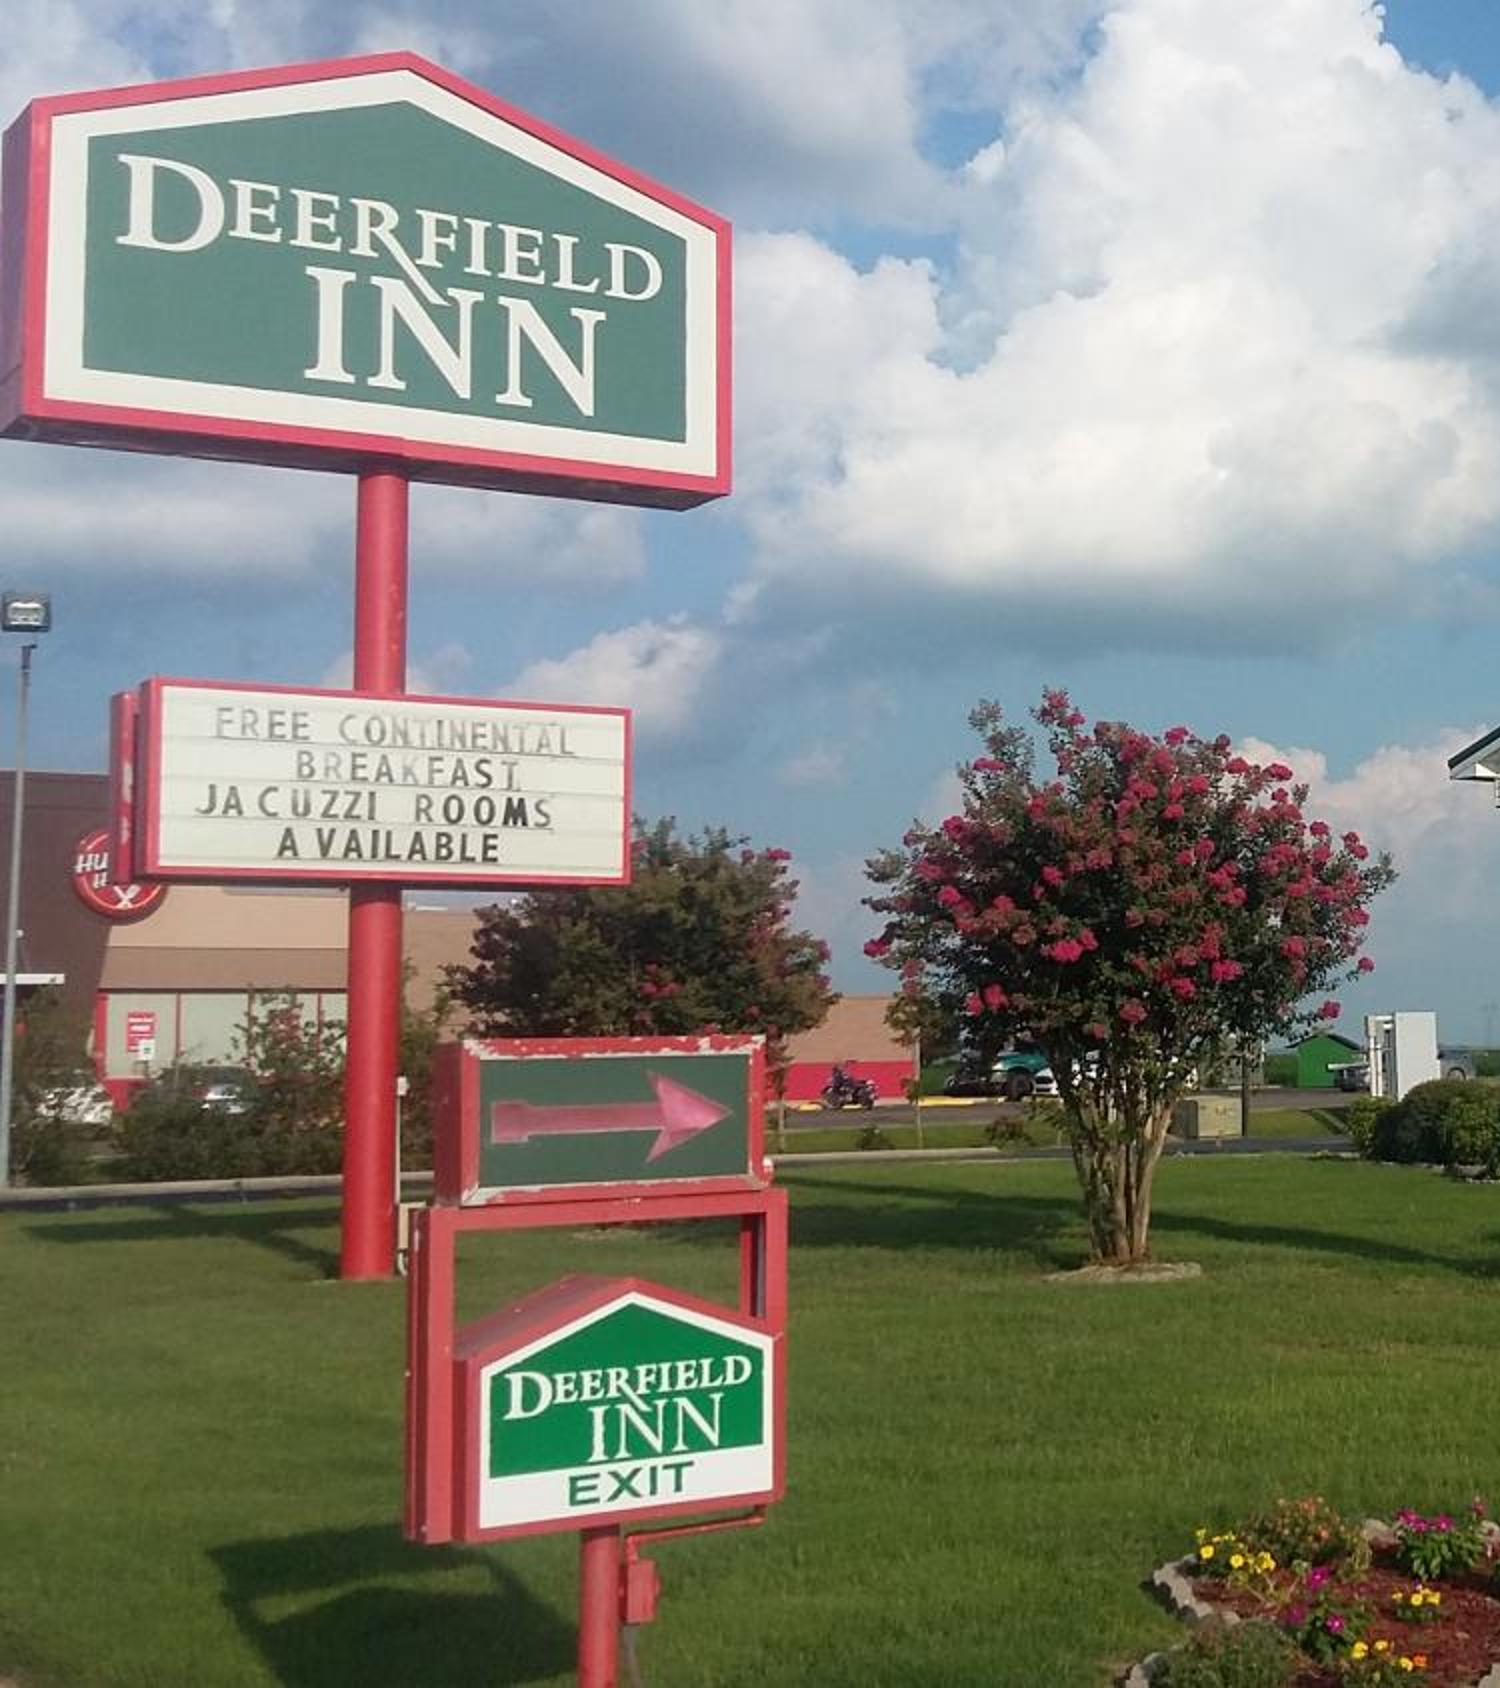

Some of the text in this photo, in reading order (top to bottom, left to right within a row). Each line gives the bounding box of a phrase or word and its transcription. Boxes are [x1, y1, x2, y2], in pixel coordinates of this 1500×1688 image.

[117, 153, 663, 304] DEERFIELD
[304, 265, 607, 417] INN
[215, 706, 575, 756] FREE CONTINENTAL
[296, 749, 520, 792] BREAKFAST
[414, 793, 552, 828] ROOMS
[503, 1355, 752, 1420] DEERFIELD
[585, 1392, 723, 1463] INN
[568, 1460, 695, 1507] EXIT
